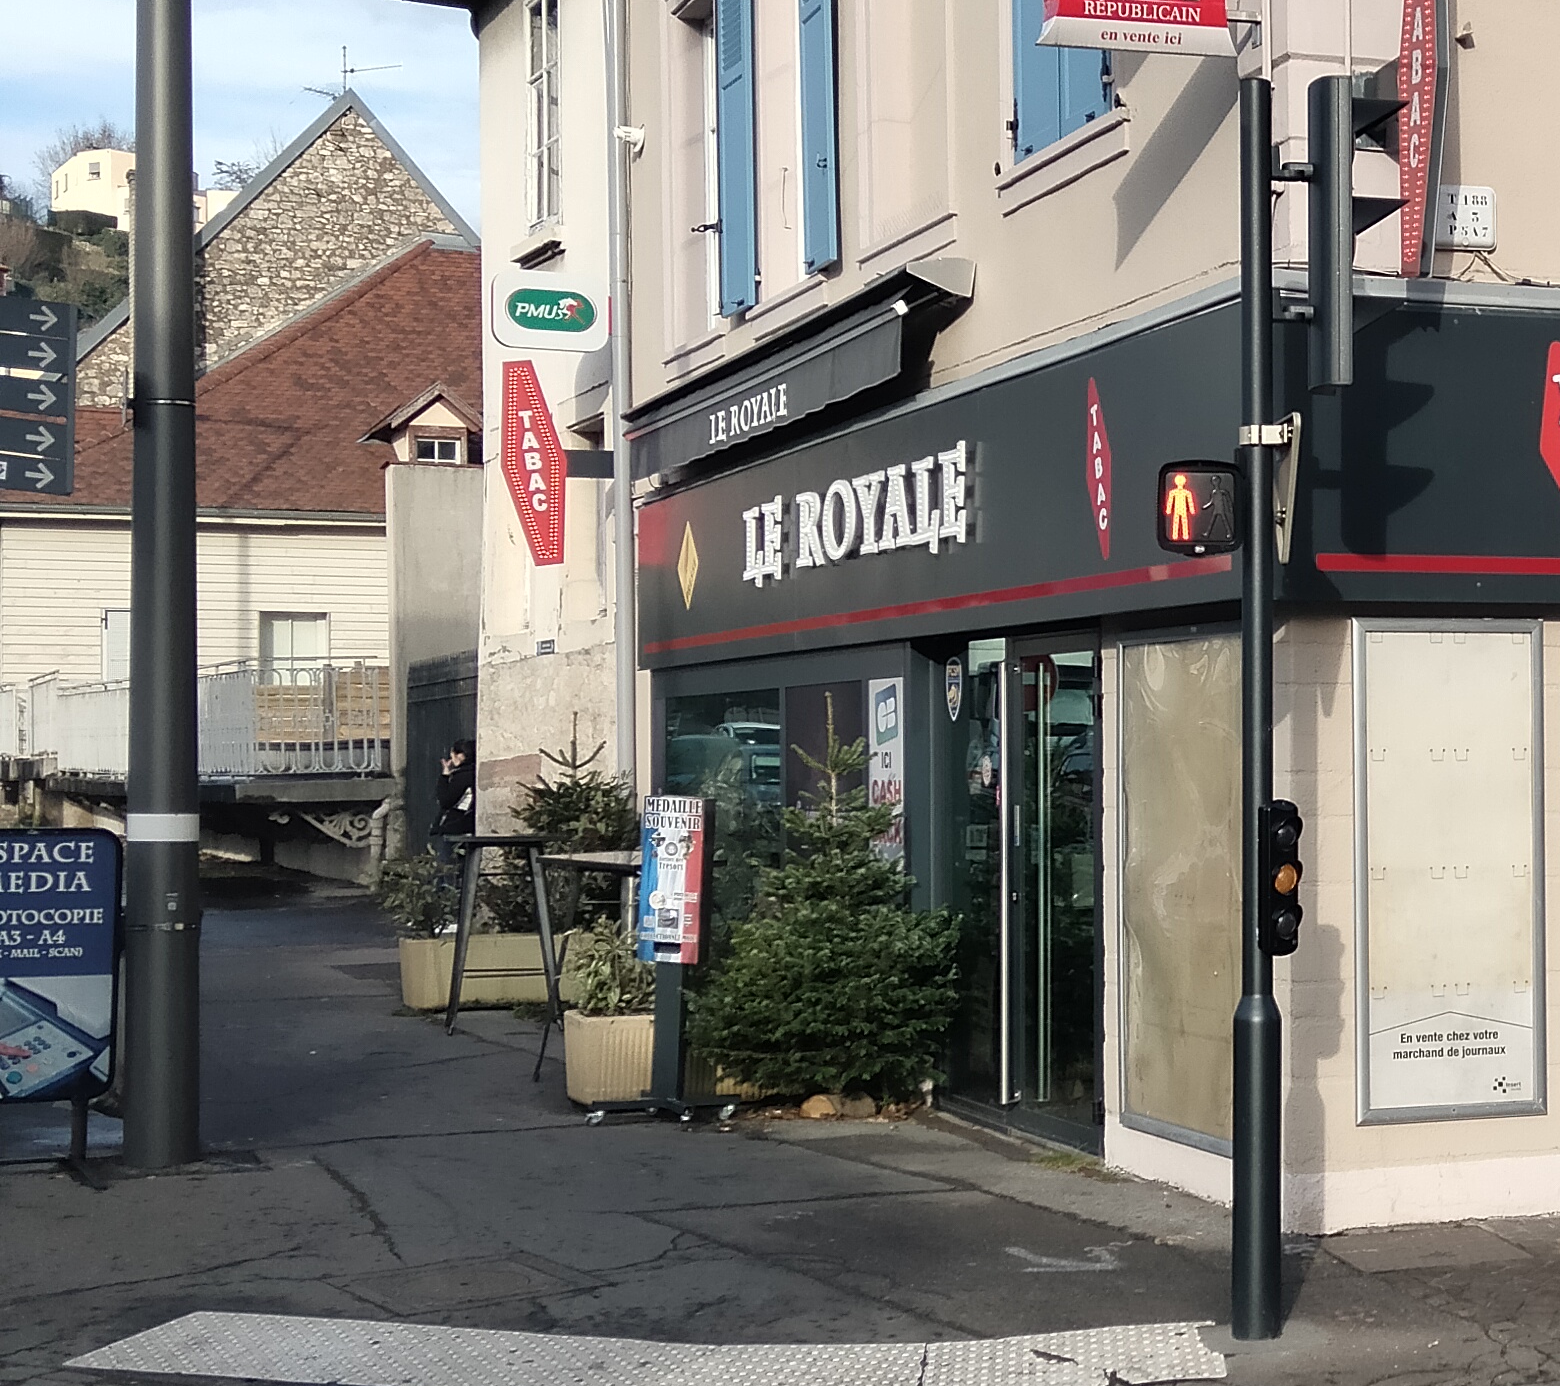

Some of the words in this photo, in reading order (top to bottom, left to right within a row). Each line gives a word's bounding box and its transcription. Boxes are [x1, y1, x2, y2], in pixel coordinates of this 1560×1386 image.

[1101, 30, 1117, 41] en
[1122, 31, 1160, 44] vente
[1164, 31, 1182, 45] ici
[515, 302, 557, 319] PMU
[709, 414, 726, 444] LE
[729, 383, 788, 436] ROYALE
[518, 410, 548, 513] TABAC
[1090, 404, 1108, 530] TABAC
[742, 495, 782, 588] LE
[795, 440, 967, 568] ROYALE
[881, 751, 892, 769] ICI
[646, 798, 702, 814] MEDAILLE
[645, 815, 701, 830] SOUVENIR
[0, 871, 92, 893] EDIA
[38, 929, 66, 945] A4
[10, 948, 41, 959] MAIL
[1400, 1033, 1413, 1043] En
[1416, 1032, 1443, 1043] vente
[1446, 1031, 1470, 1041] chez
[1473, 1029, 1499, 1040] votre
[1393, 1047, 1444, 1059] marchand
[1447, 1046, 1459, 1057] de
[1462, 1046, 1506, 1059] journaux
